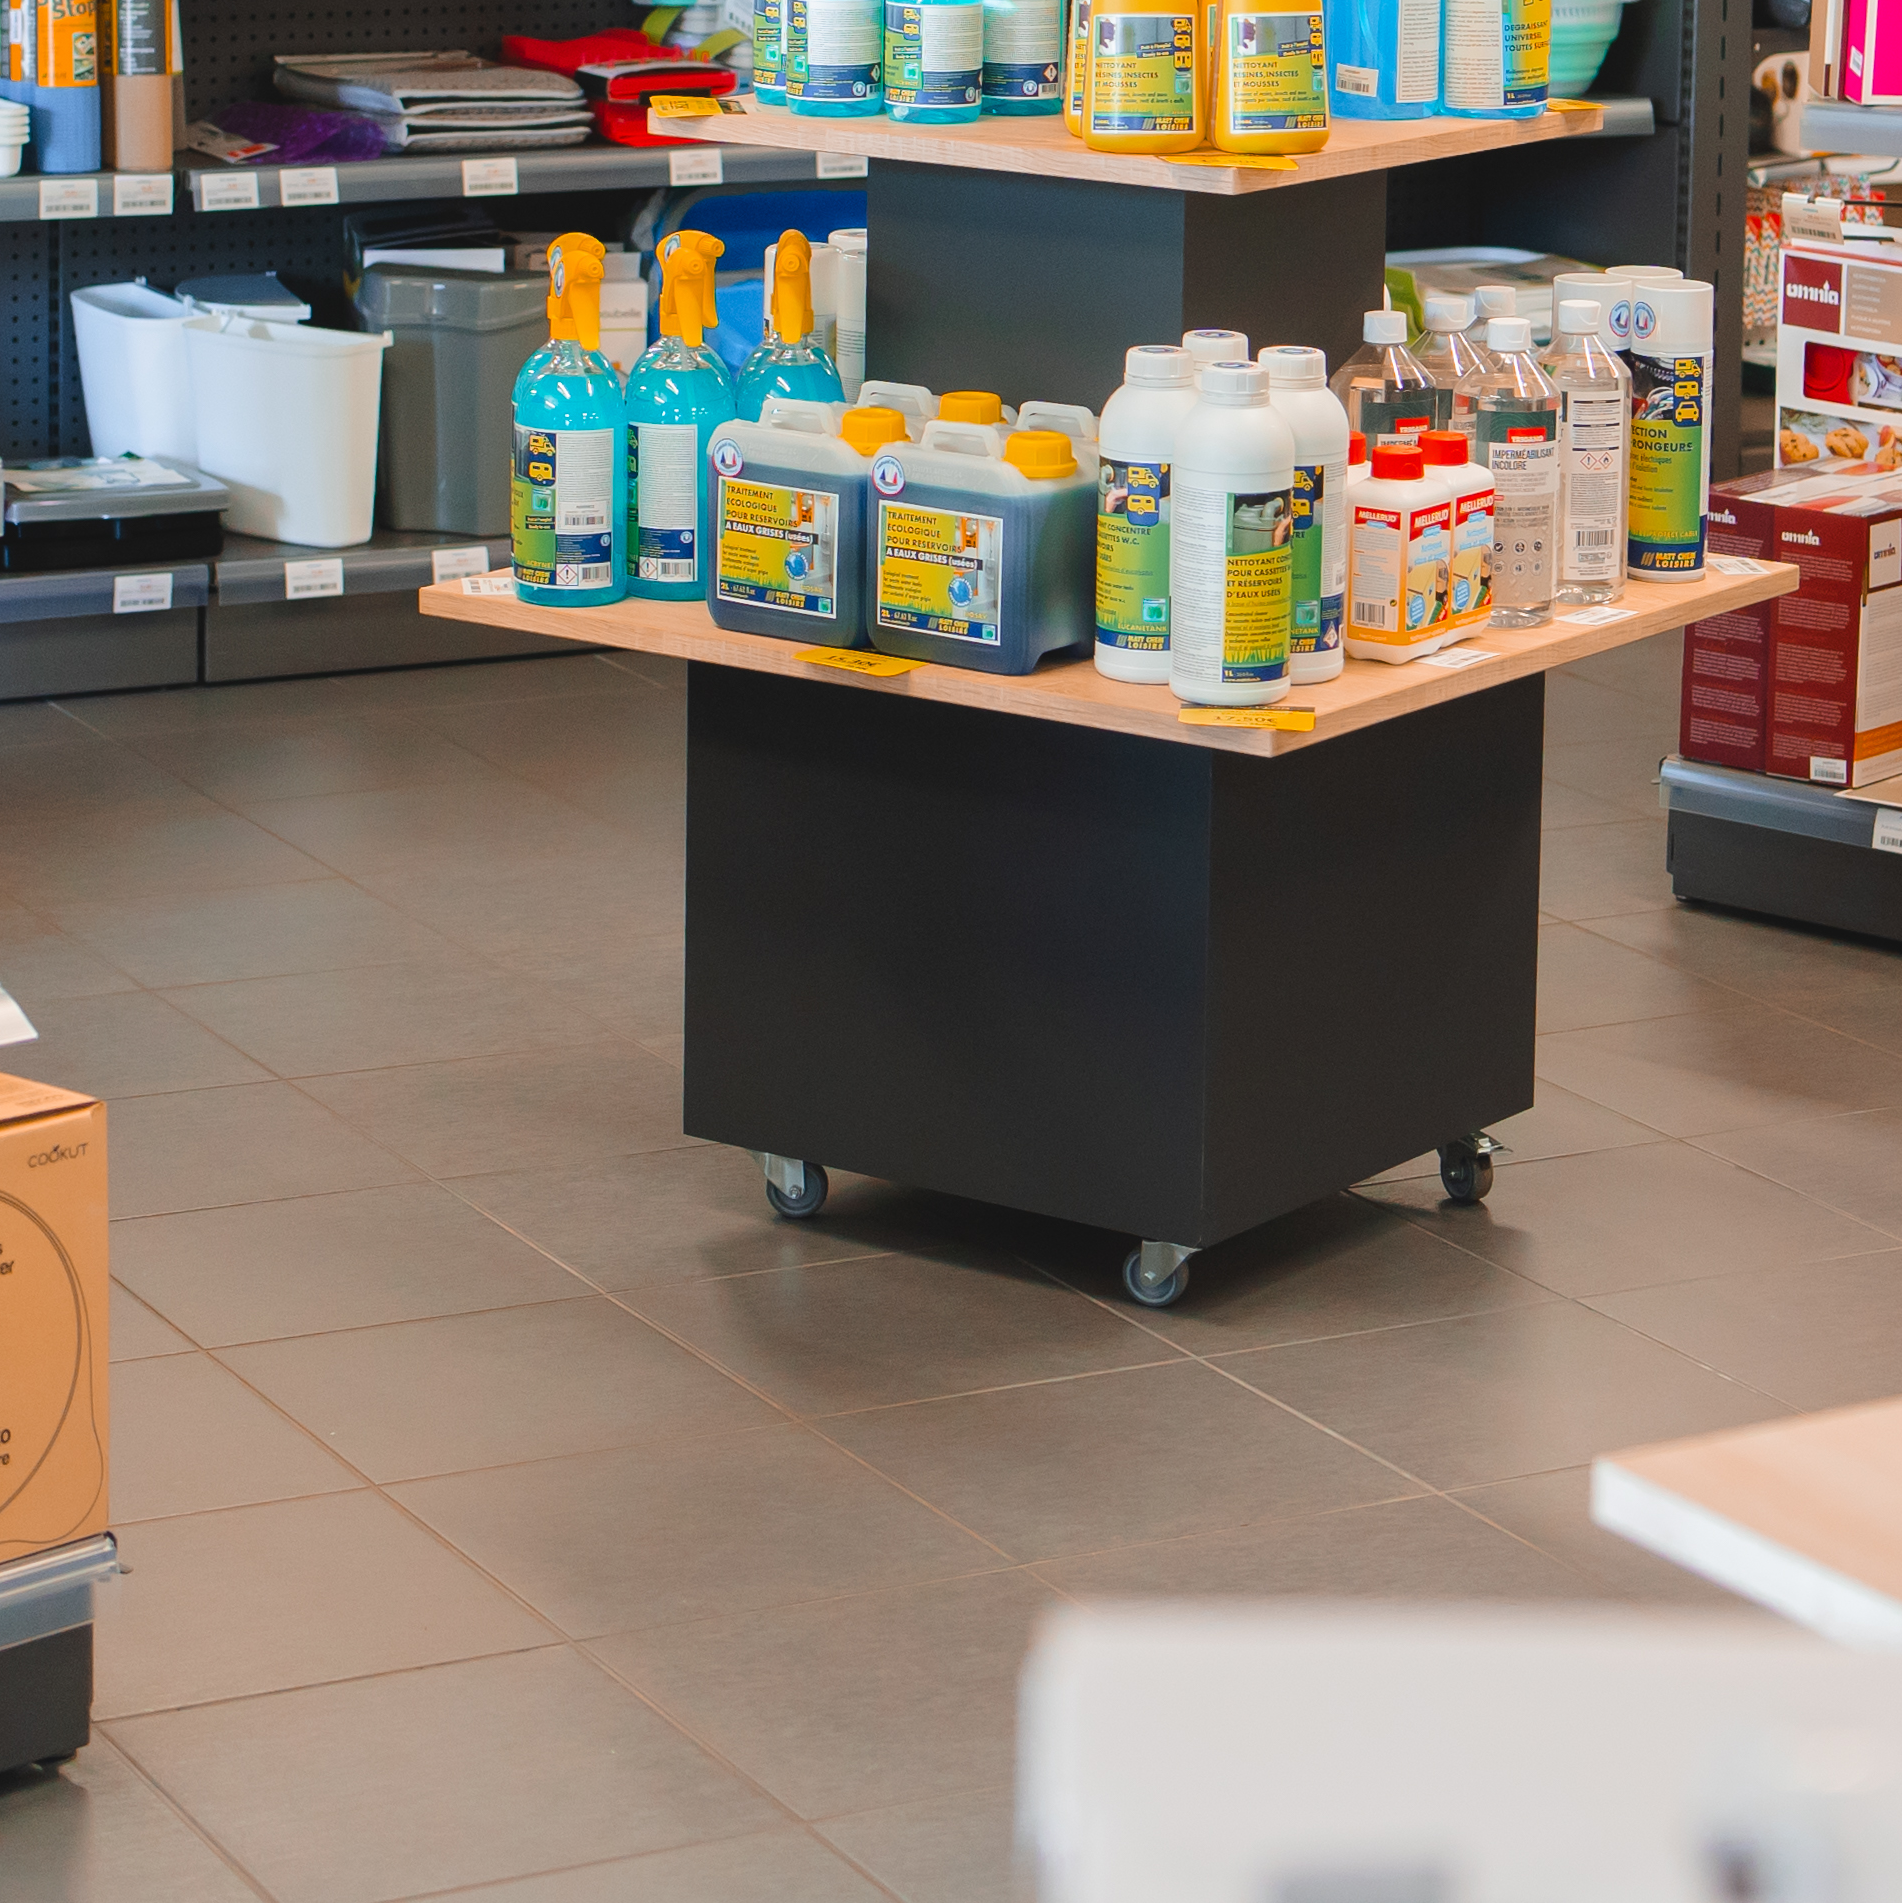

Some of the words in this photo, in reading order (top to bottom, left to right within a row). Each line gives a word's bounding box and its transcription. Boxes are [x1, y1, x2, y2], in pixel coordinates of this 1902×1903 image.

[1504, 43, 1533, 52] TOUTES
[1233, 61, 1278, 69] NETTOYANT
[1102, 80, 1138, 88] MOUSSES
[1242, 80, 1280, 88] MOUSSES
[1784, 279, 1841, 307] omnia
[1491, 460, 1528, 471] INCOLORE
[726, 485, 774, 500] TRAITEMENT
[726, 509, 749, 520] POUR
[887, 511, 937, 526] TRAITEMENT
[1357, 510, 1398, 523] MELLERUD
[1413, 508, 1450, 529] MELLERUD
[733, 522, 755, 534] EAUX
[755, 526, 784, 538] GRISES
[784, 530, 814, 544] (usées)
[1780, 528, 1821, 547] omnia
[886, 535, 910, 546] POUR
[1122, 537, 1140, 546] W.C.
[893, 548, 917, 560] EAUX
[917, 552, 948, 564] GRISES
[948, 557, 978, 569] (usées)
[1655, 551, 1676, 561] MATT
[1676, 551, 1697, 561] CHEM
[1227, 557, 1276, 567] NETTOYANT
[1655, 558, 1696, 569] LOISIRS
[1227, 569, 1252, 577] POUR
[1253, 565, 1287, 577] CASSETTES
[1227, 578, 1236, 588] ET
[1227, 590, 1259, 599] D'EAUX
[775, 597, 806, 608] LOISIRS
[937, 624, 969, 635] LOISIRS
[1127, 642, 1164, 651] LOISIRS
